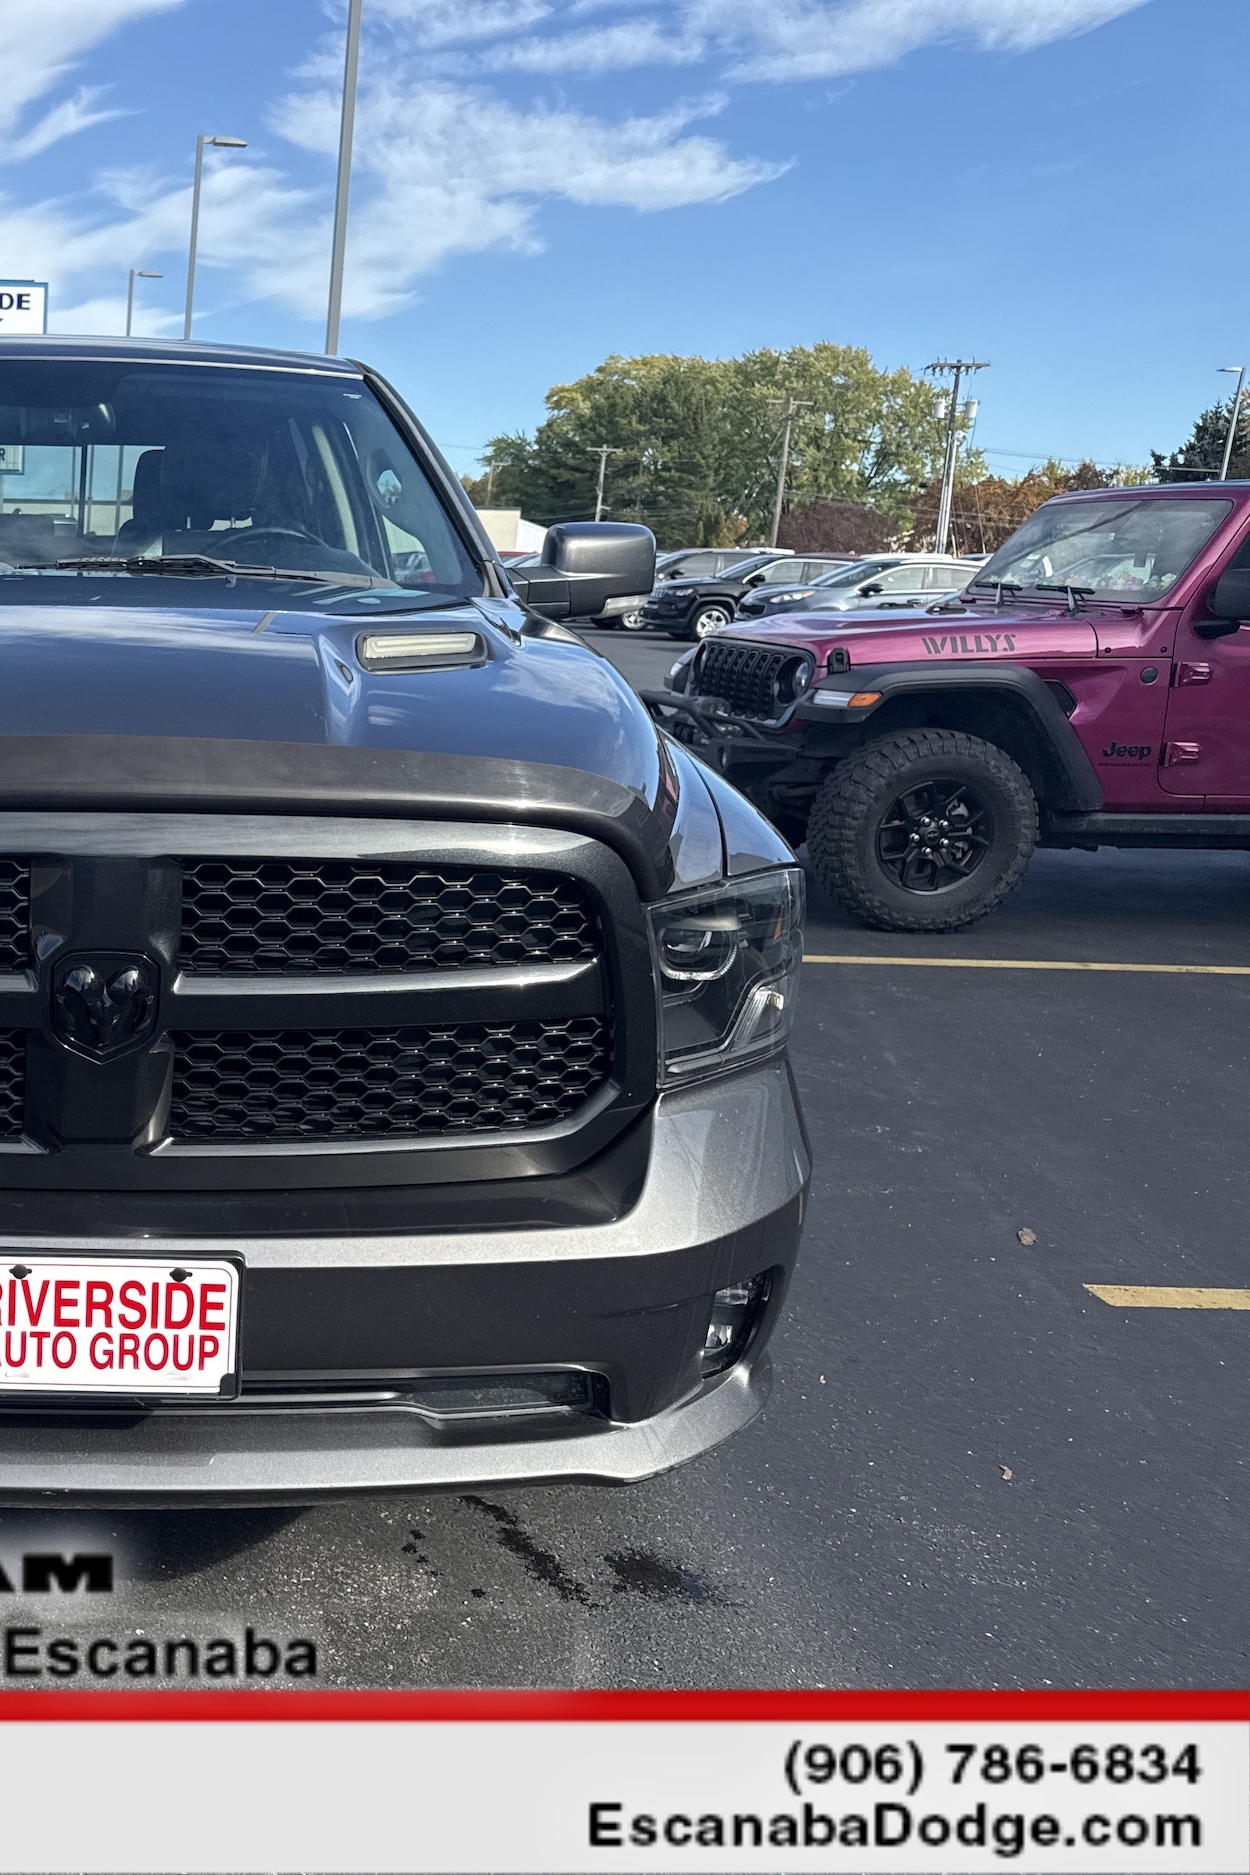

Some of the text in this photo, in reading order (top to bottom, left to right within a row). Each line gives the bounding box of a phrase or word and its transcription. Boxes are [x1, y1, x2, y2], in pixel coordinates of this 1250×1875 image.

[921, 634, 1016, 654] WILLYS
[1102, 741, 1152, 760] Jeep
[89, 1332, 220, 1371] GROUP
